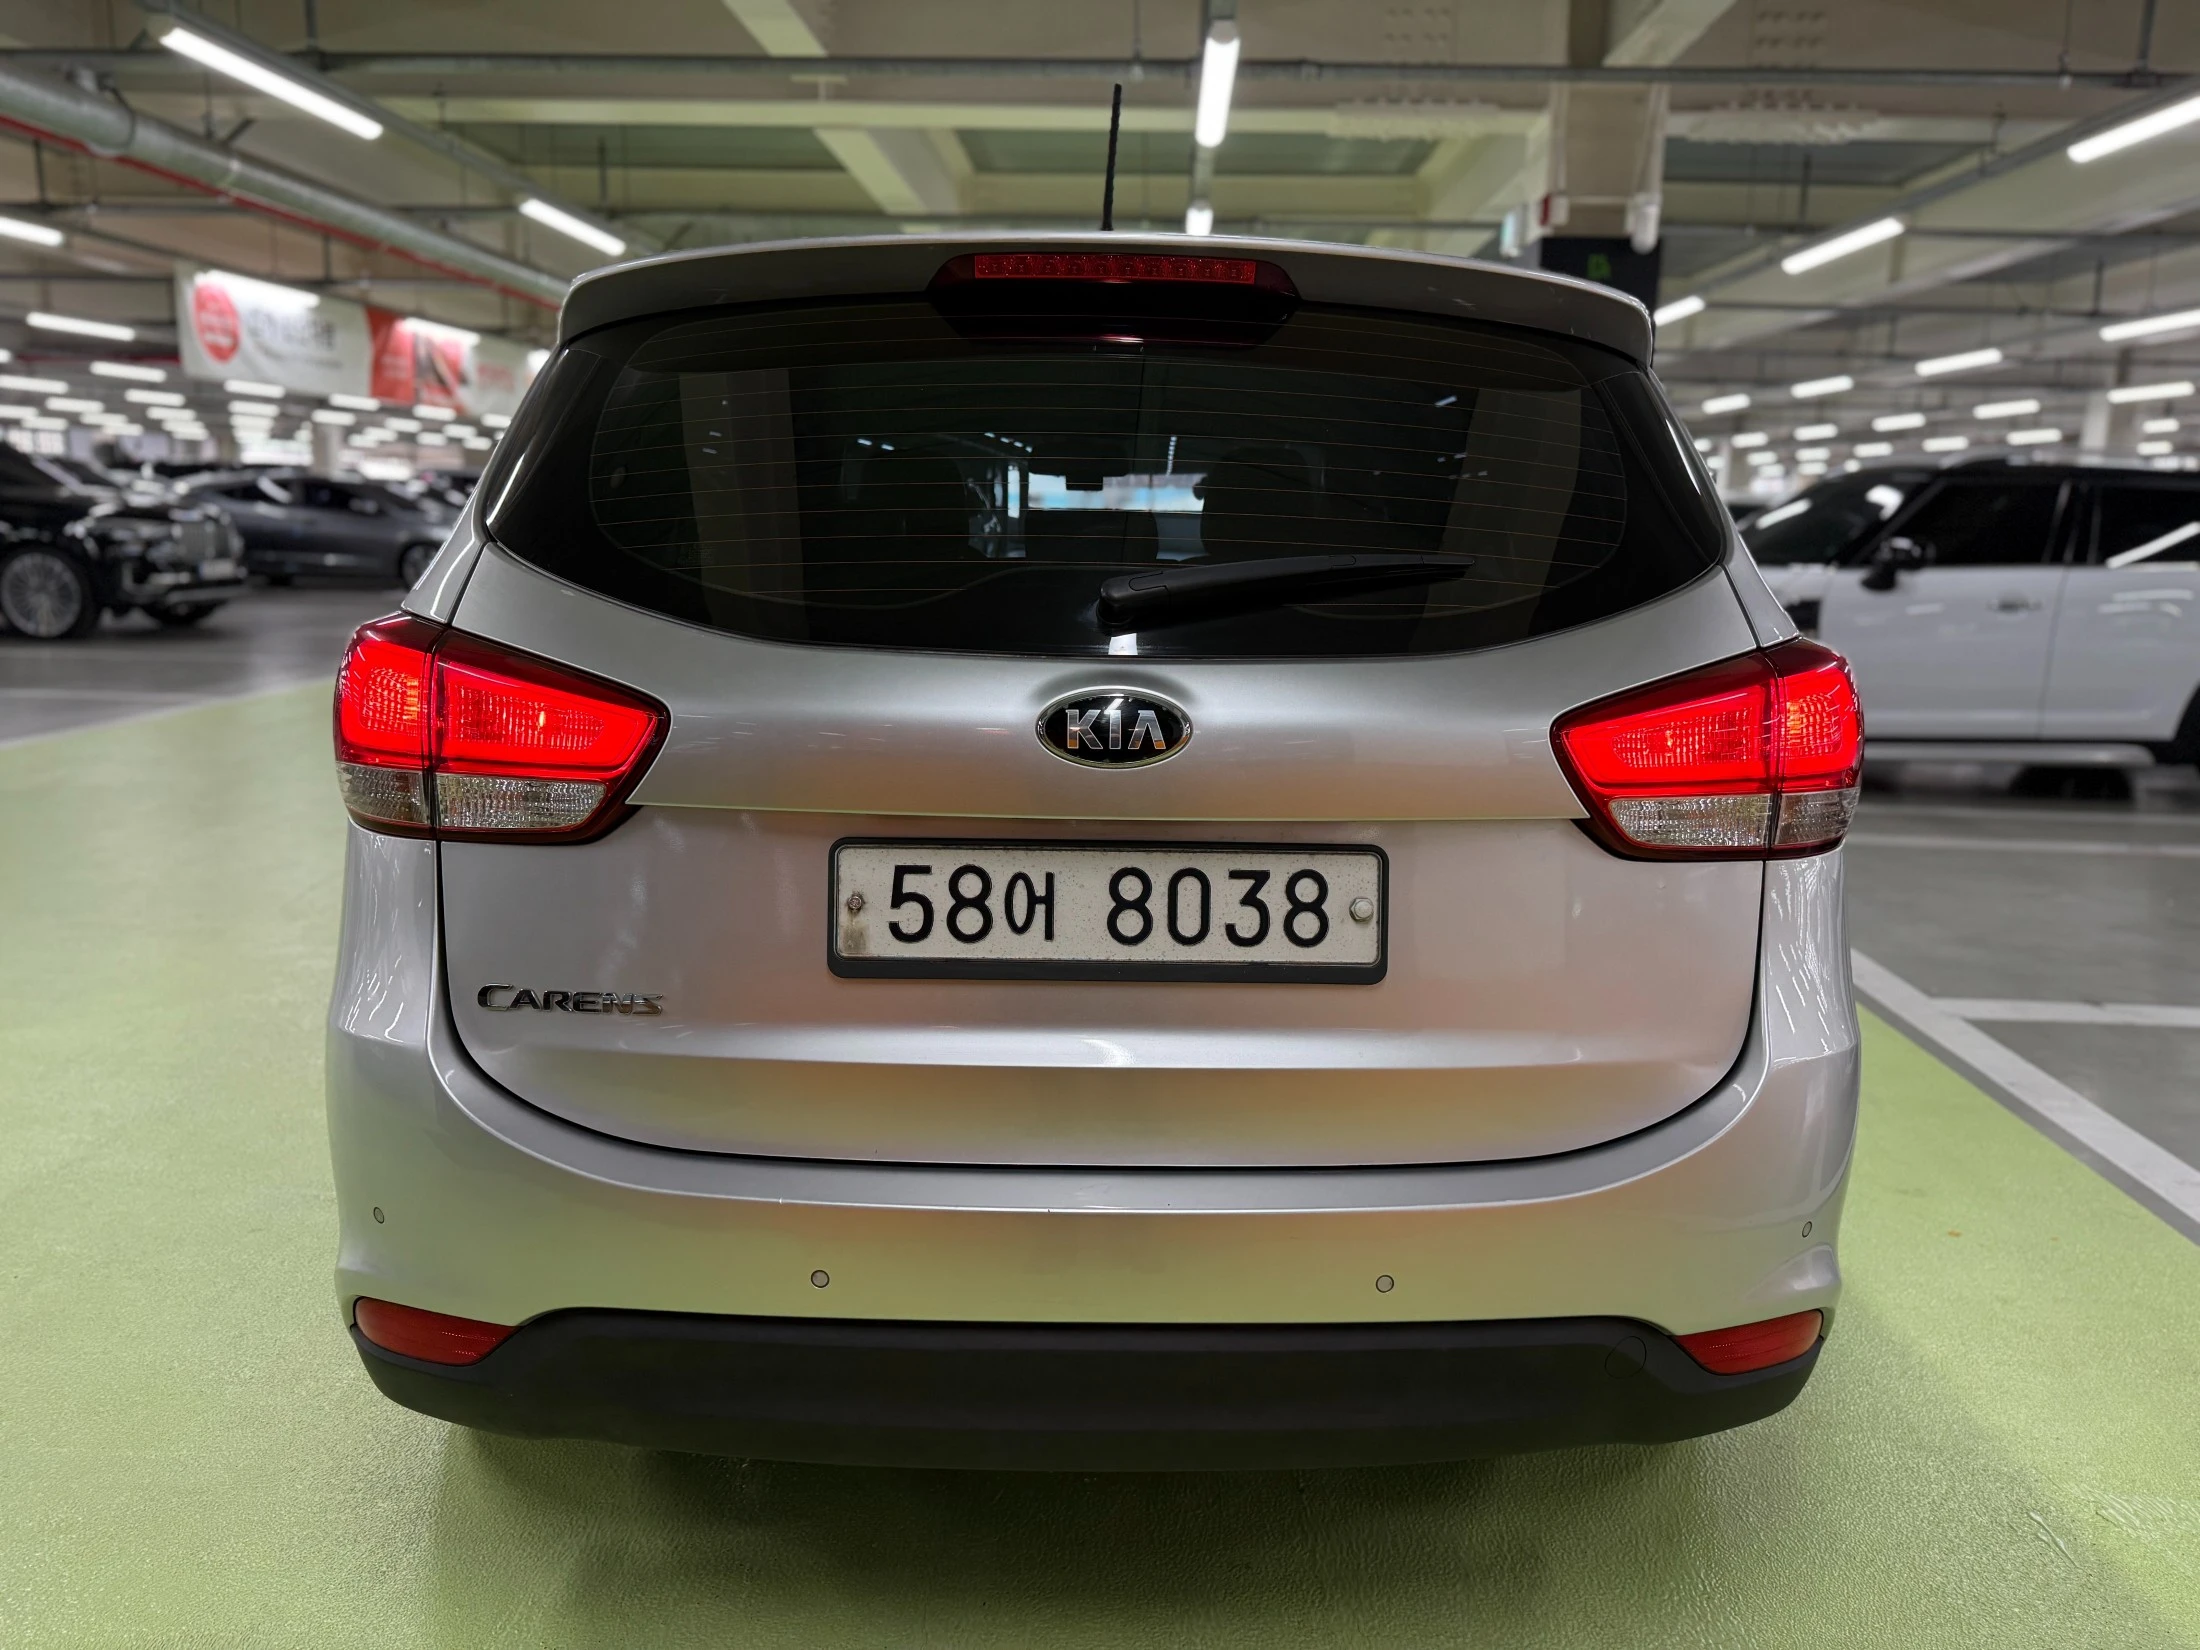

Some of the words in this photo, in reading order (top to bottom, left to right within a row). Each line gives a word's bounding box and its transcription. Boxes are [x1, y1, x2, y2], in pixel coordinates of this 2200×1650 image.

[1065, 709, 1167, 750] KIA
[888, 863, 1055, 944] 58어
[1107, 866, 1329, 948] 8038
[477, 983, 664, 1016] CARENS
